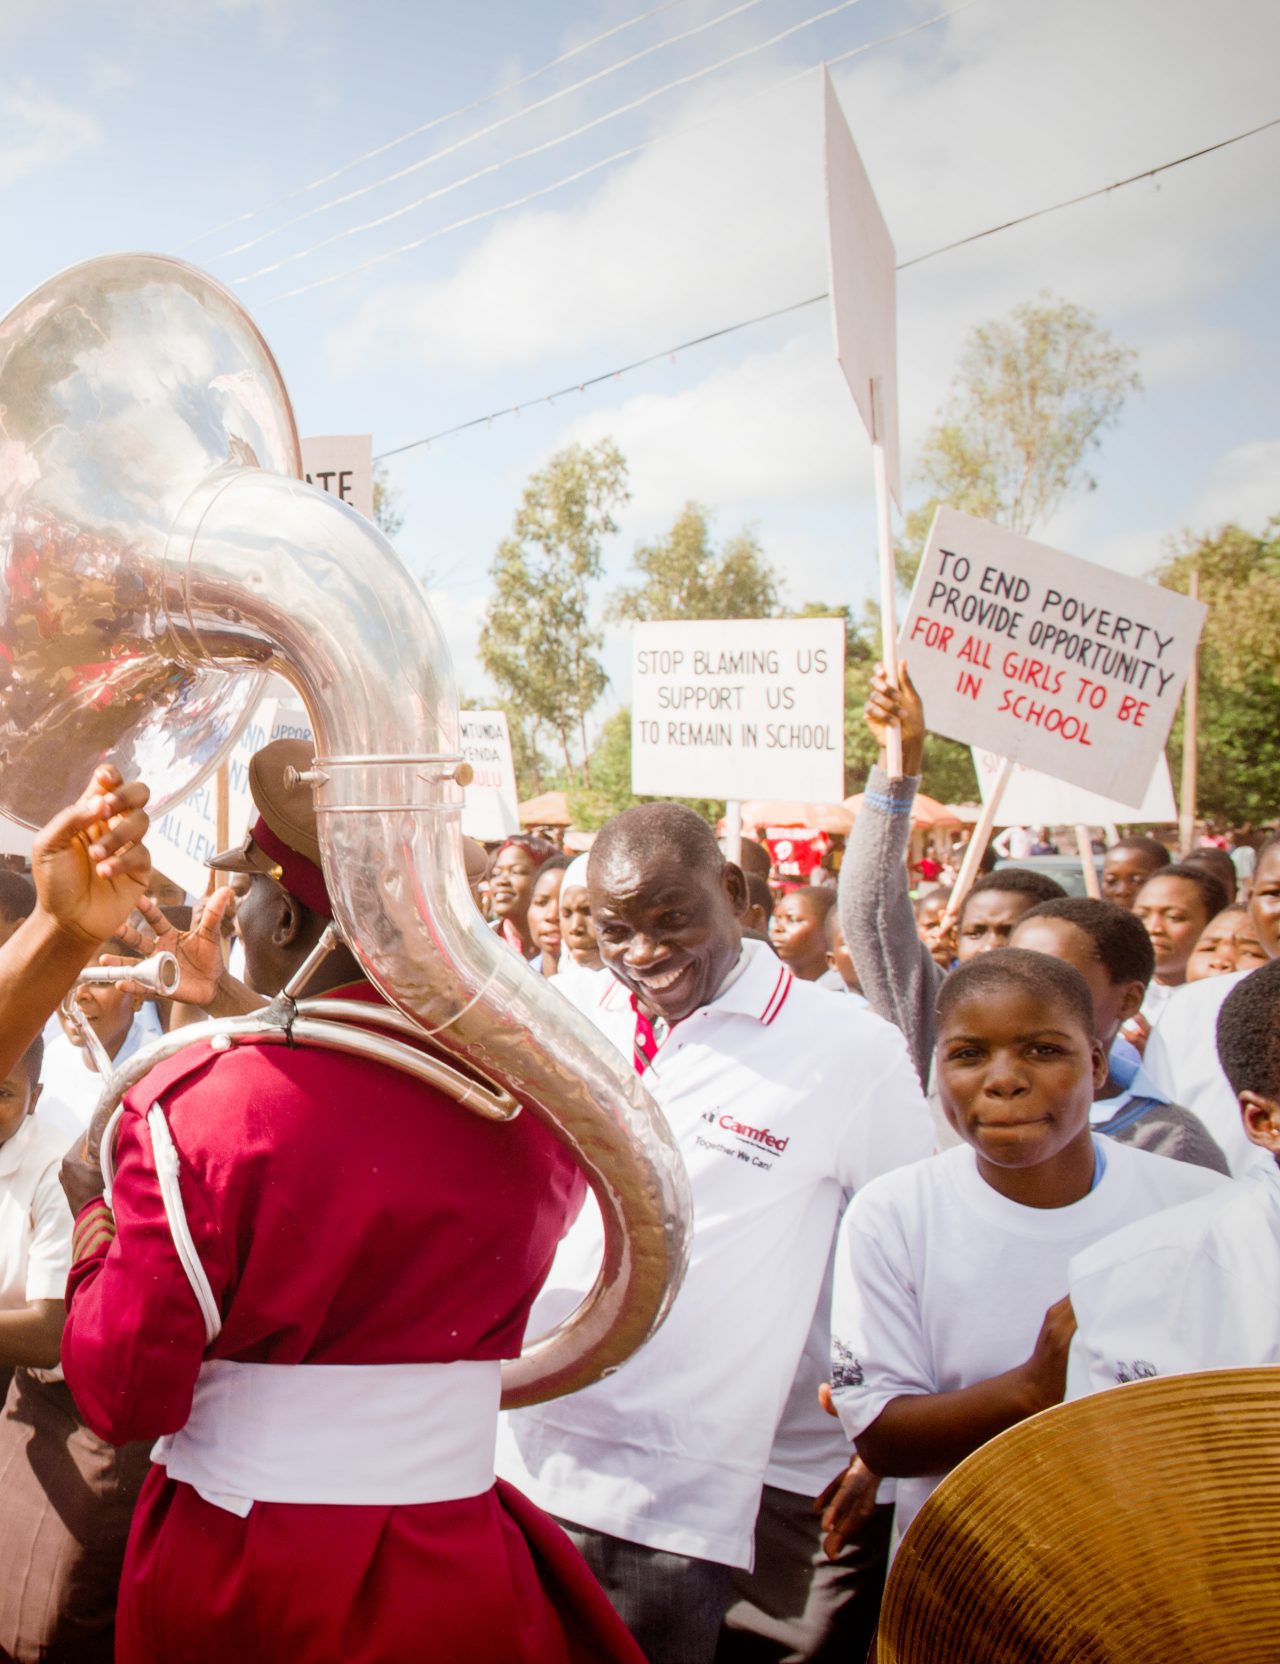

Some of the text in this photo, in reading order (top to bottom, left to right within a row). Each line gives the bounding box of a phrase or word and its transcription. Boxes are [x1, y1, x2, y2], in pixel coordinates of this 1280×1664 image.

[938, 549, 1174, 659] TO END POVERTY
[928, 581, 1175, 698] PROVIDE OPPORTUNITY
[637, 649, 828, 675] STOP BLAMING US
[910, 616, 1150, 728] FOR ALL GIRLS TO BE
[658, 687, 795, 710] SUPPORT US
[956, 671, 1092, 746] IN SCHOOL
[640, 721, 836, 751] TO REMAIN IN SCHOOL
[159, 815, 181, 848] ALL
[696, 1136, 735, 1156] Together
[737, 1150, 750, 1163] We
[719, 1115, 790, 1152] Camfed
